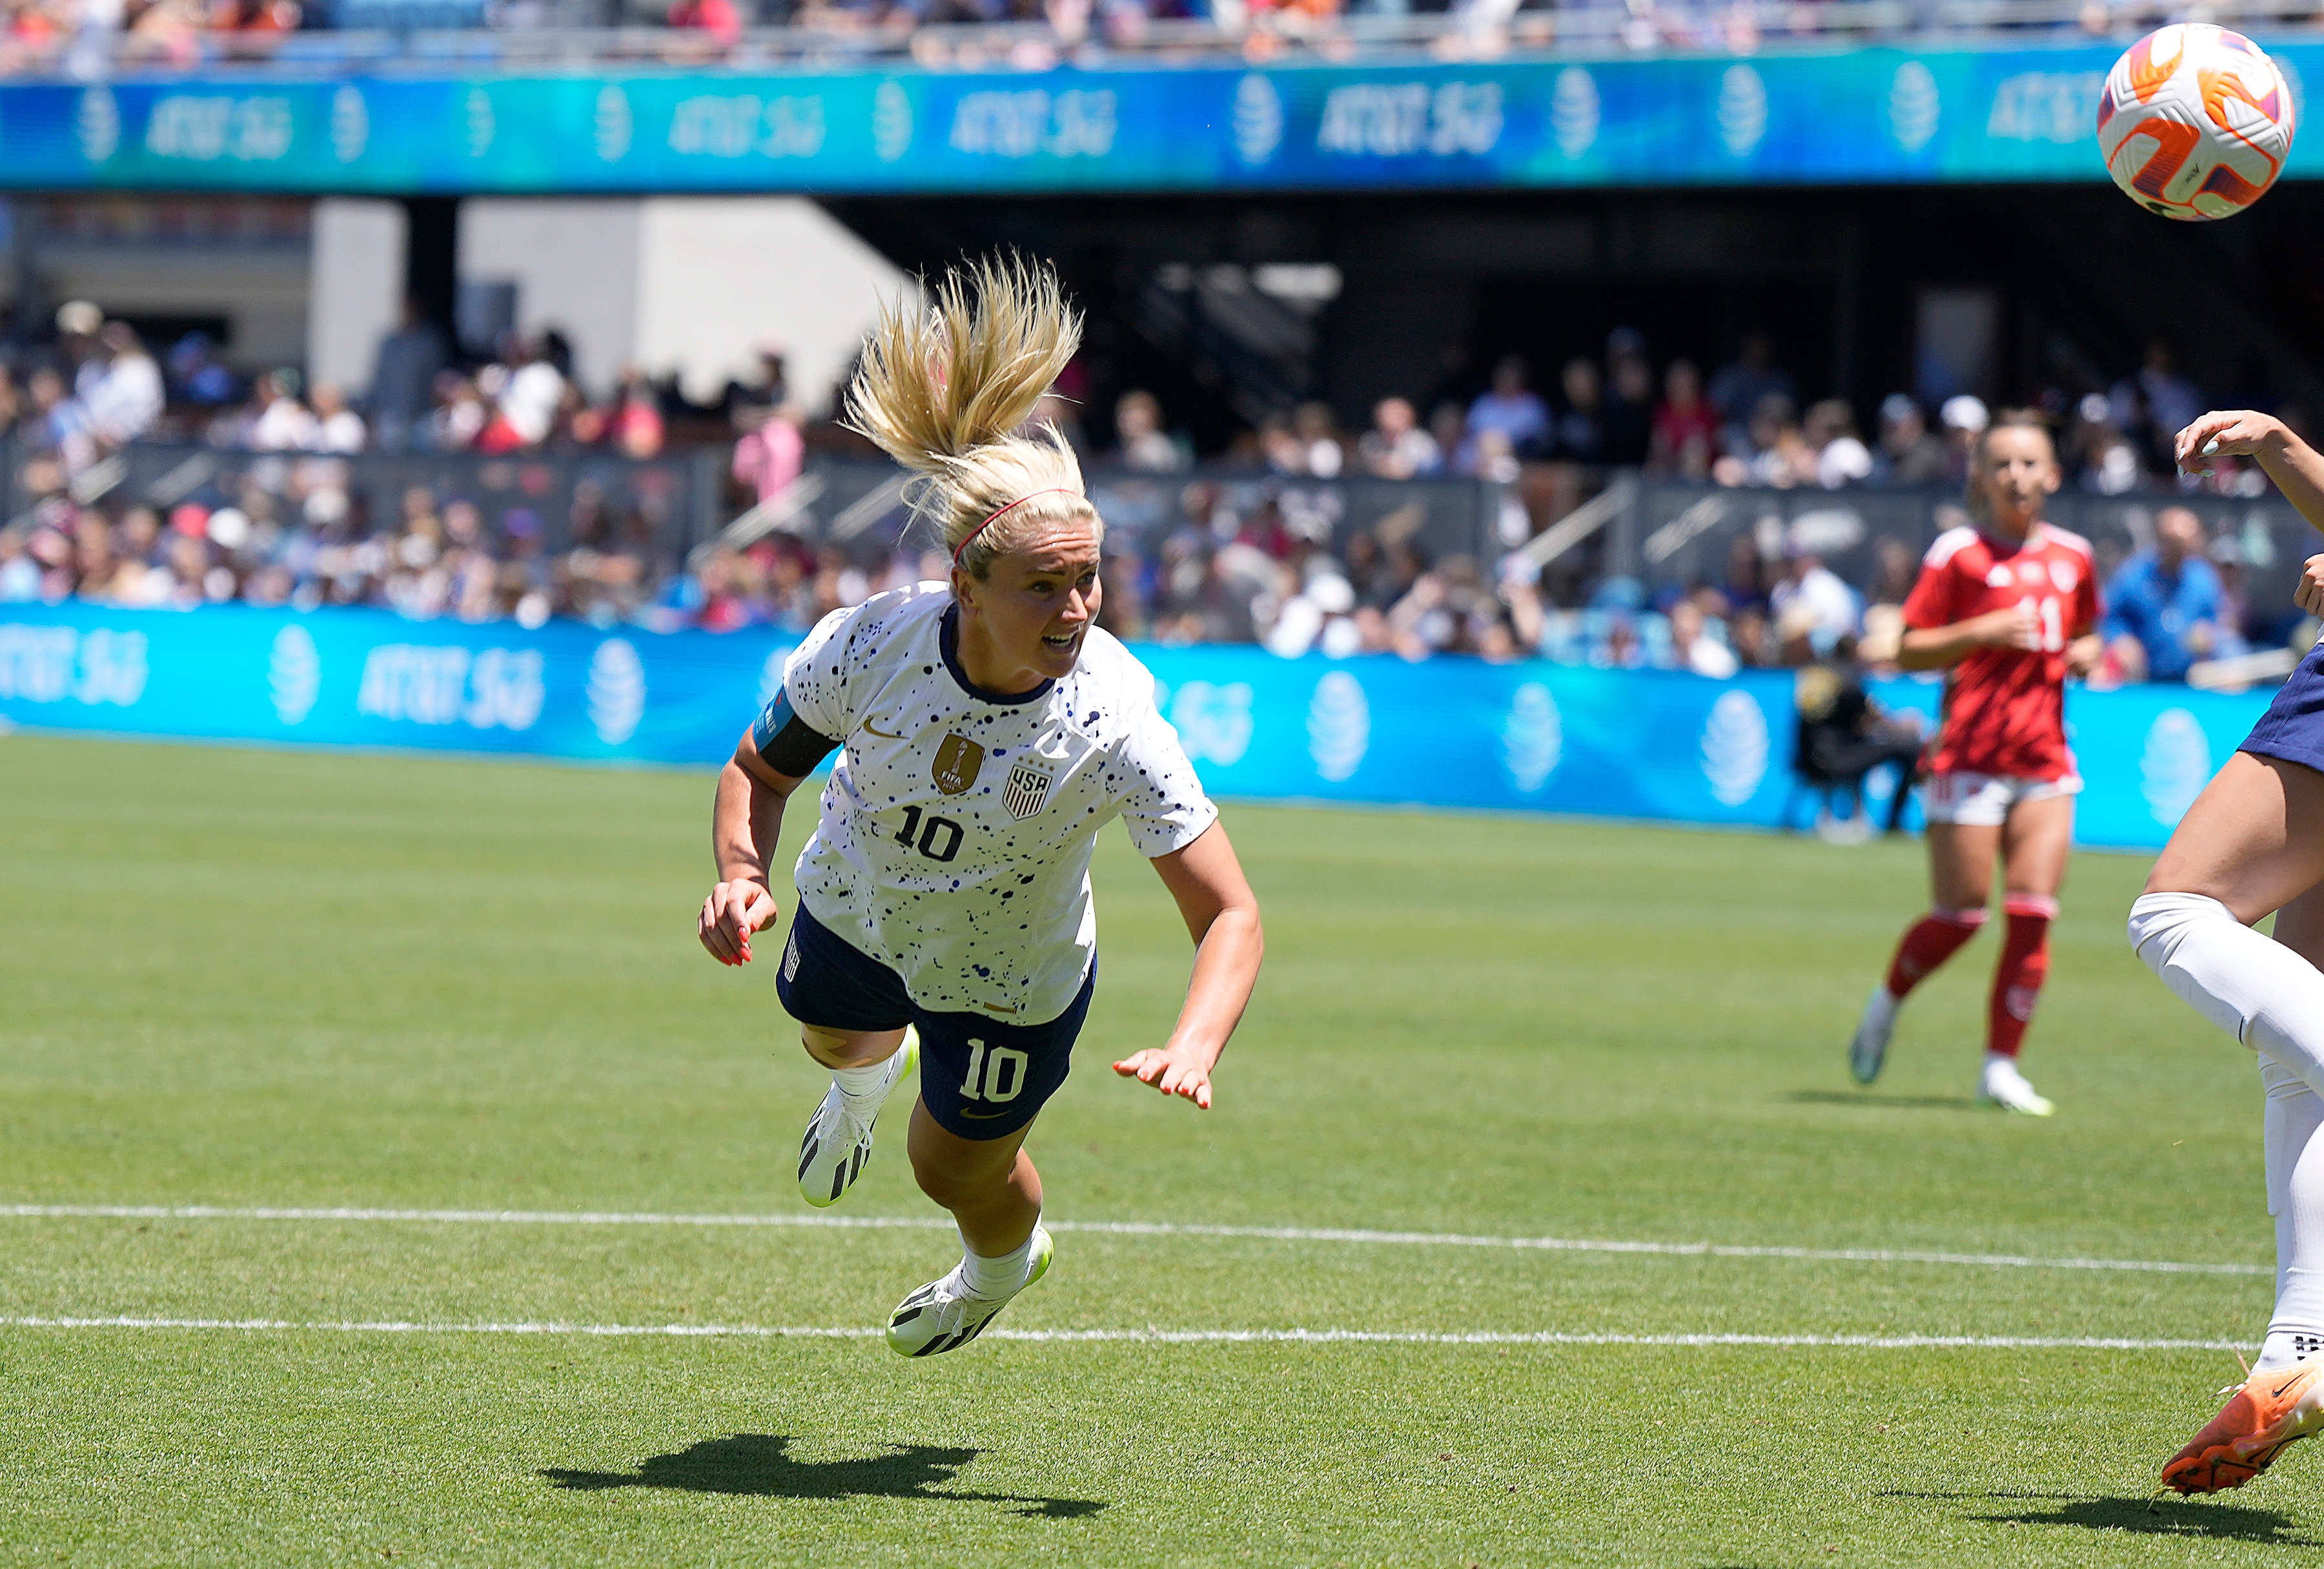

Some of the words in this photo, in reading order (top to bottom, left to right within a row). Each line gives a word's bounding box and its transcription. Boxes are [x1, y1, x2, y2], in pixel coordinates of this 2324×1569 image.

[941, 770, 962, 786] FIFA
[1012, 768, 1048, 792] USA
[893, 805, 964, 863] 10
[959, 1038, 1028, 1103] 10
